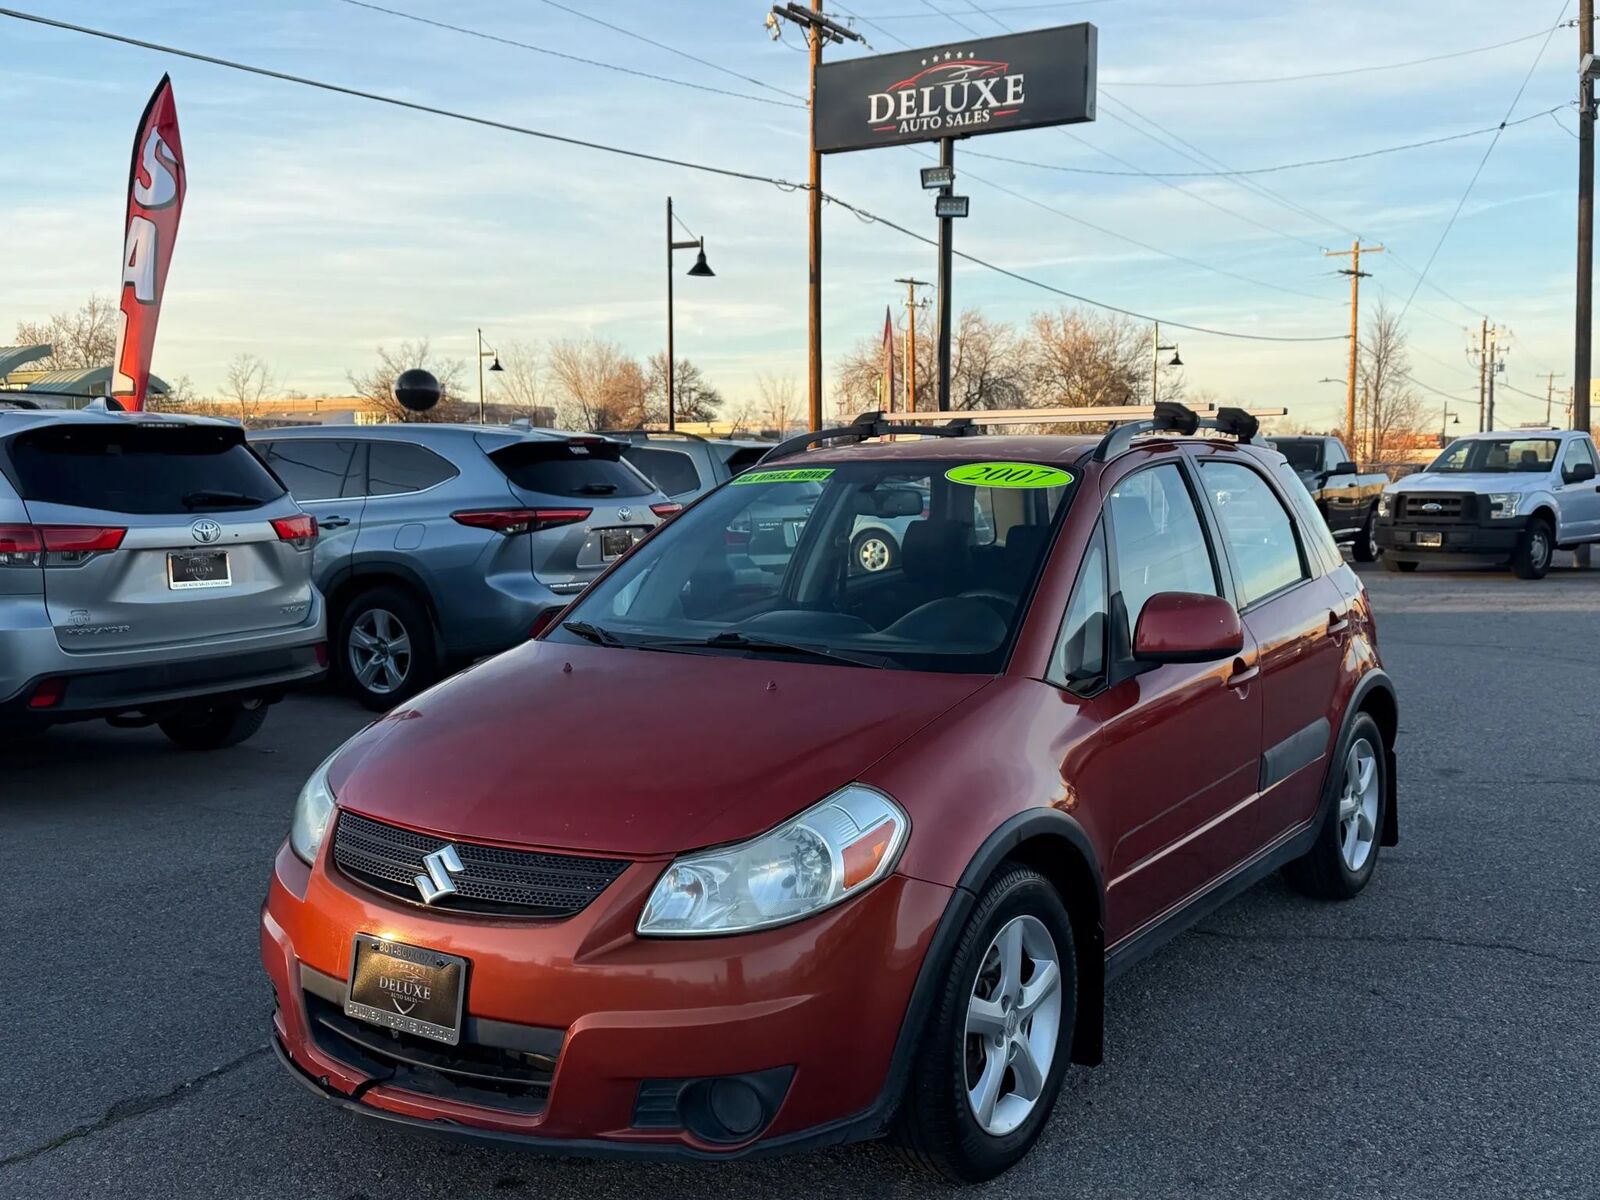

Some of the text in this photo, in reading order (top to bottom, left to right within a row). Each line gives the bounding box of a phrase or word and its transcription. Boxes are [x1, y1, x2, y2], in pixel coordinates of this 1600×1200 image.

[867, 74, 1025, 123] DELUXE
[899, 109, 990, 133] AUTO SALES
[962, 467, 1057, 483] 2007
[379, 976, 432, 1000] DELUXE
